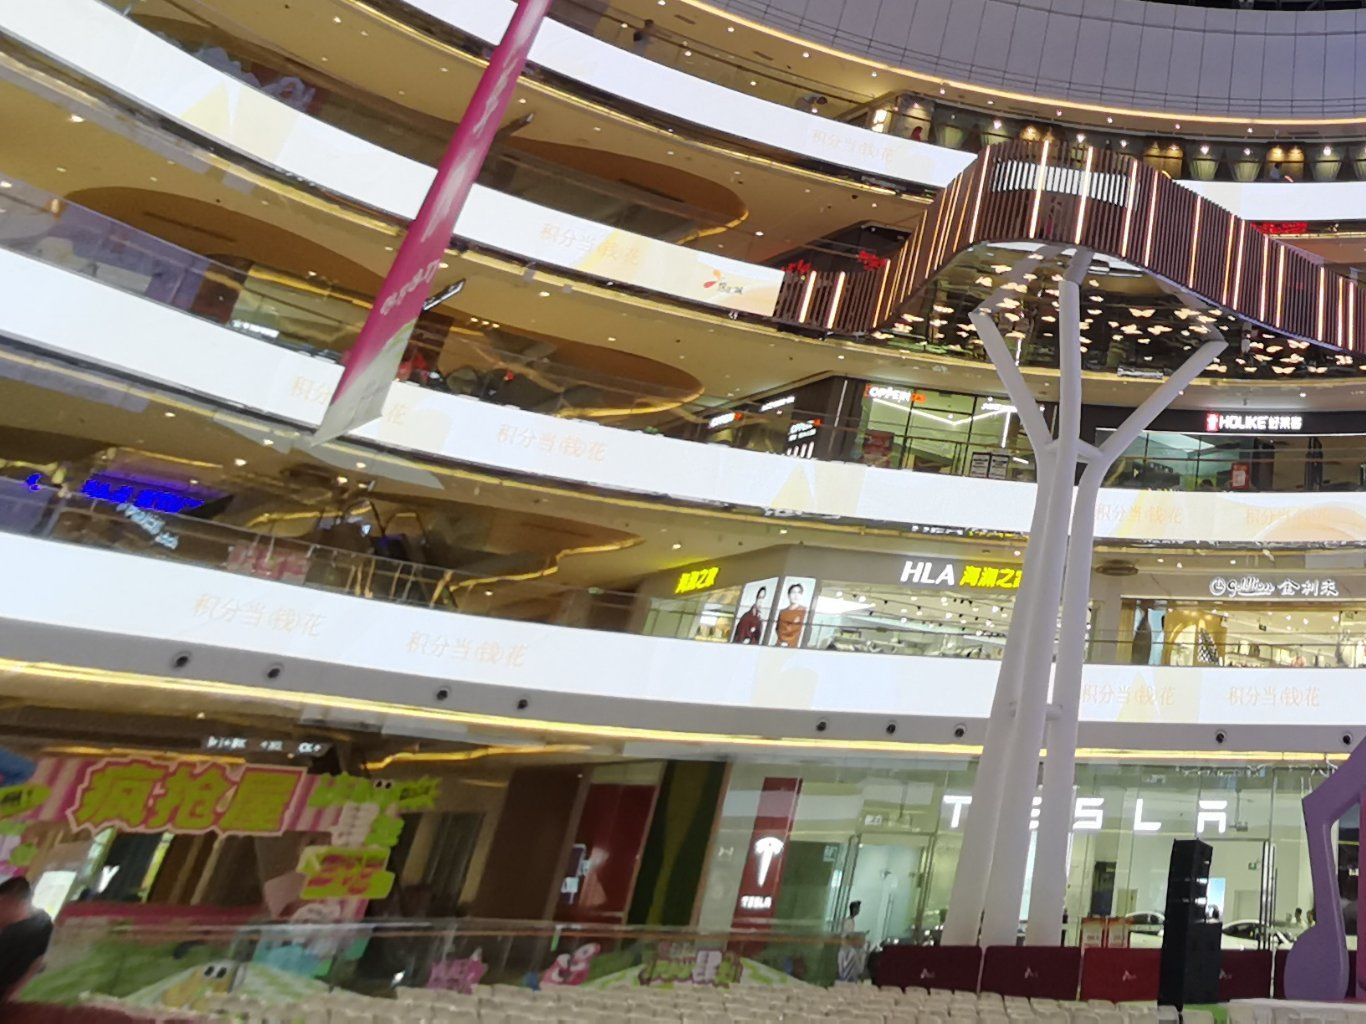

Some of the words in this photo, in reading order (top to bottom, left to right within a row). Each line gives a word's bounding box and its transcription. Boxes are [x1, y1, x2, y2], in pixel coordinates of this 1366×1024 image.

[1219, 415, 1268, 430] HOLIKE
[900, 560, 955, 586] HLA
[1277, 578, 1339, 596] 金利来
